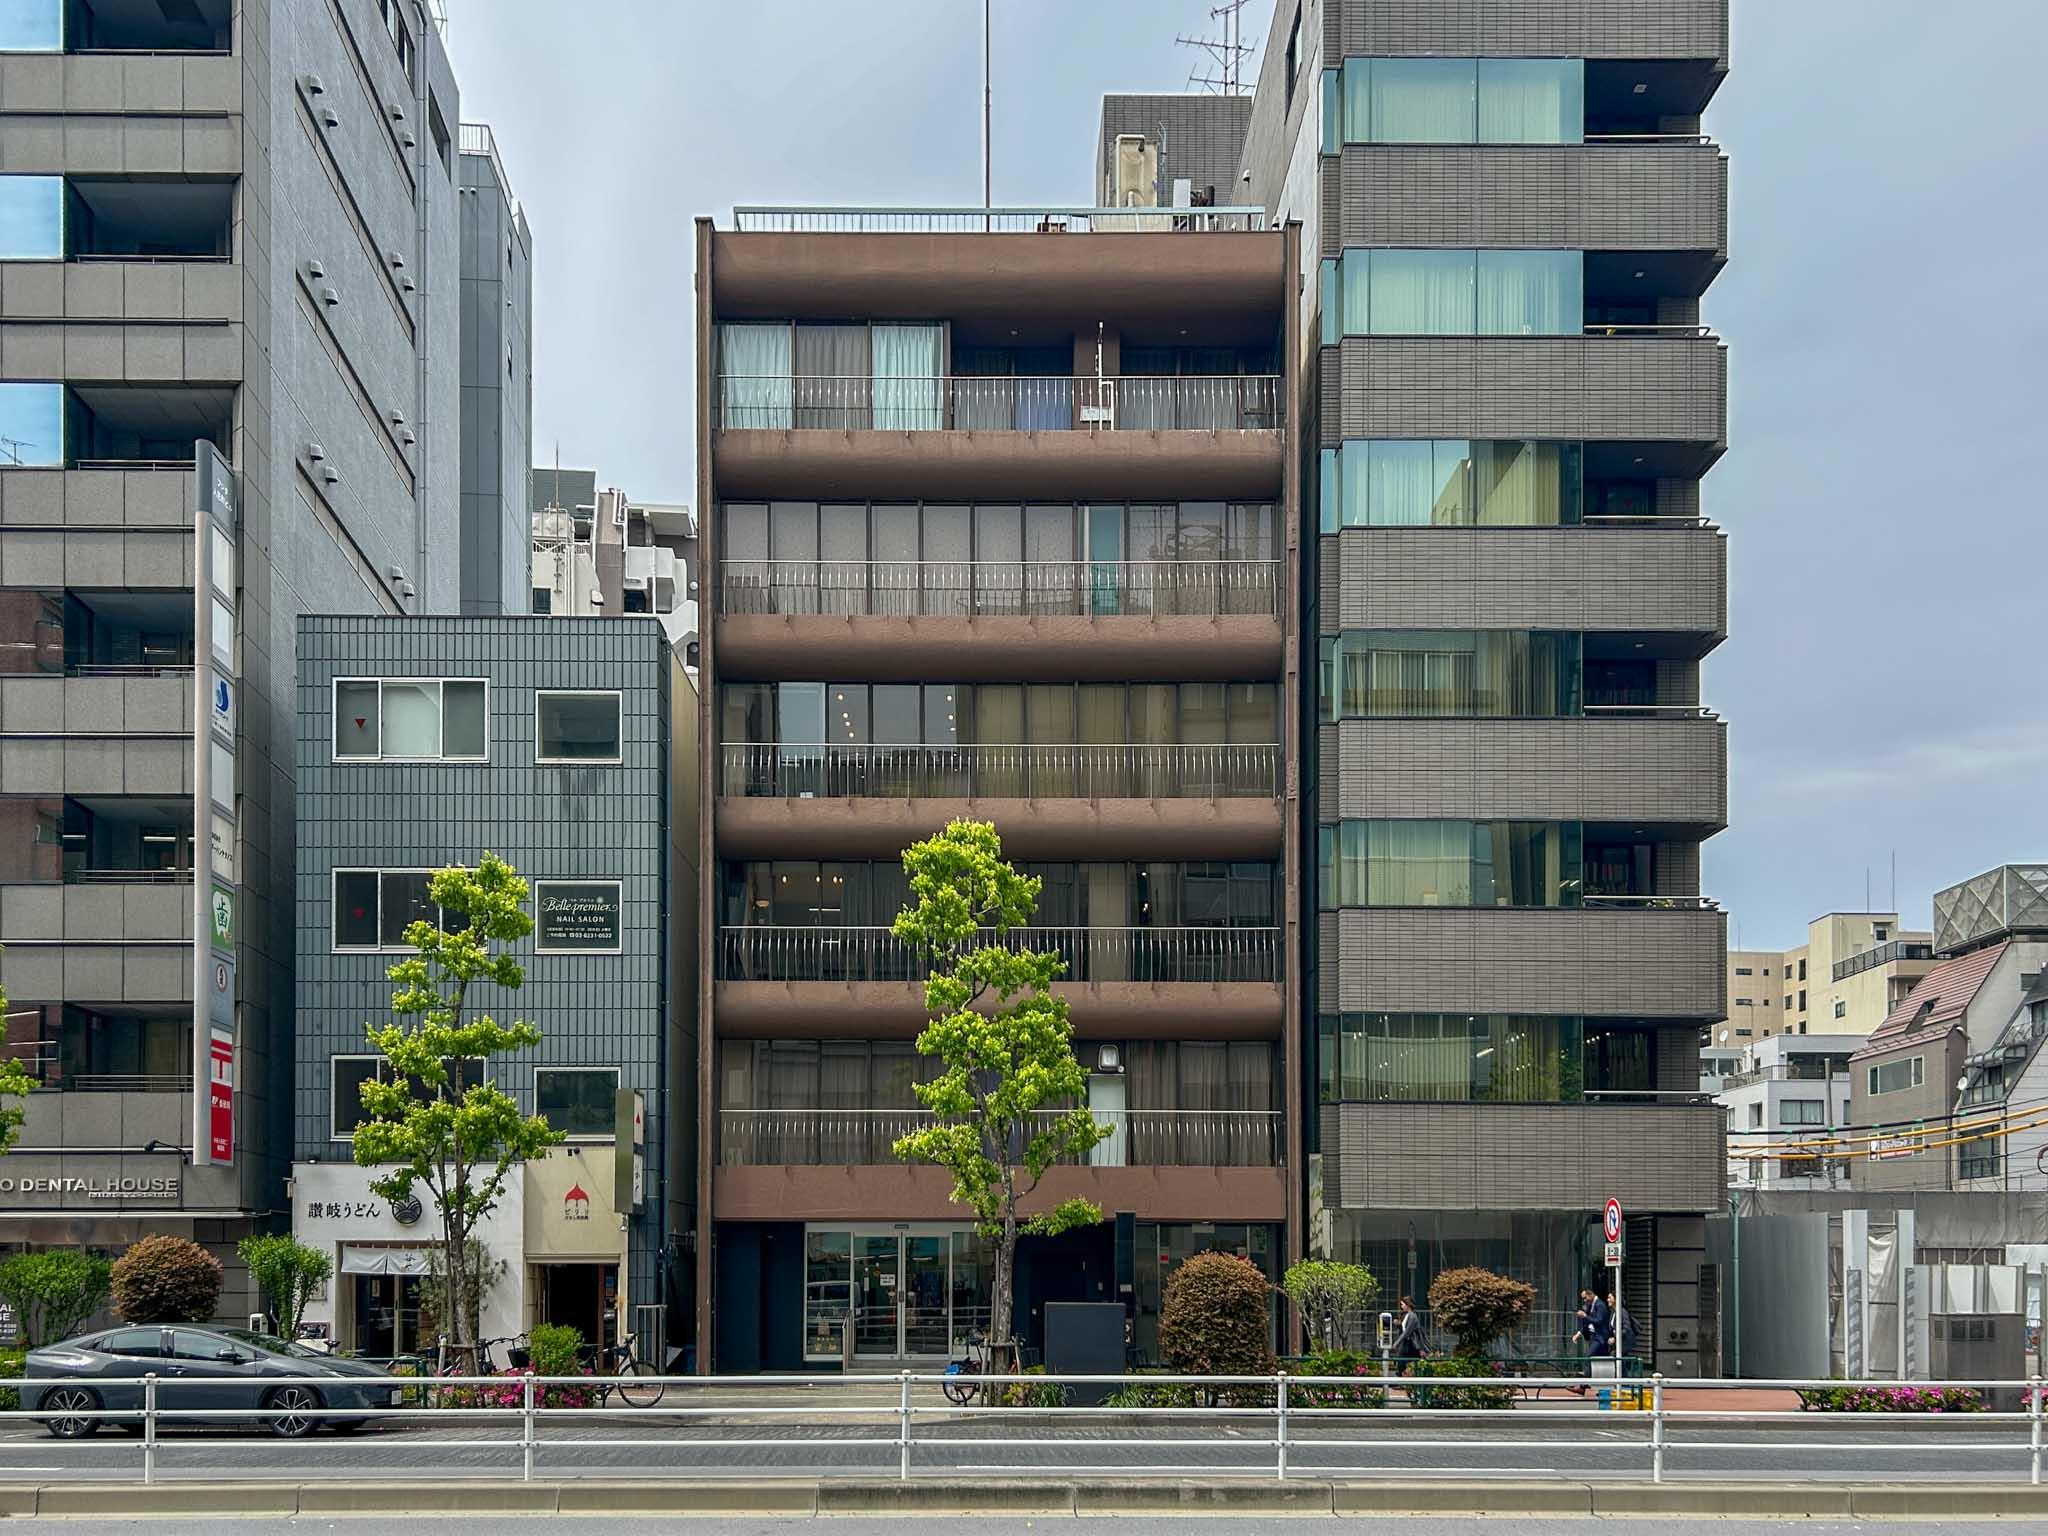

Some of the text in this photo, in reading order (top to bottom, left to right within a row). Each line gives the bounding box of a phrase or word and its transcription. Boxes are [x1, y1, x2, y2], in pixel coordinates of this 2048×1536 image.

[216, 895, 228, 928] 歯
[543, 897, 572, 912] Belle
[556, 915, 605, 923] NAIL SALON
[20, 1178, 100, 1192] DENTAL
[106, 1178, 178, 1192] HOUSE
[308, 1202, 381, 1219] 讃岐うどん
